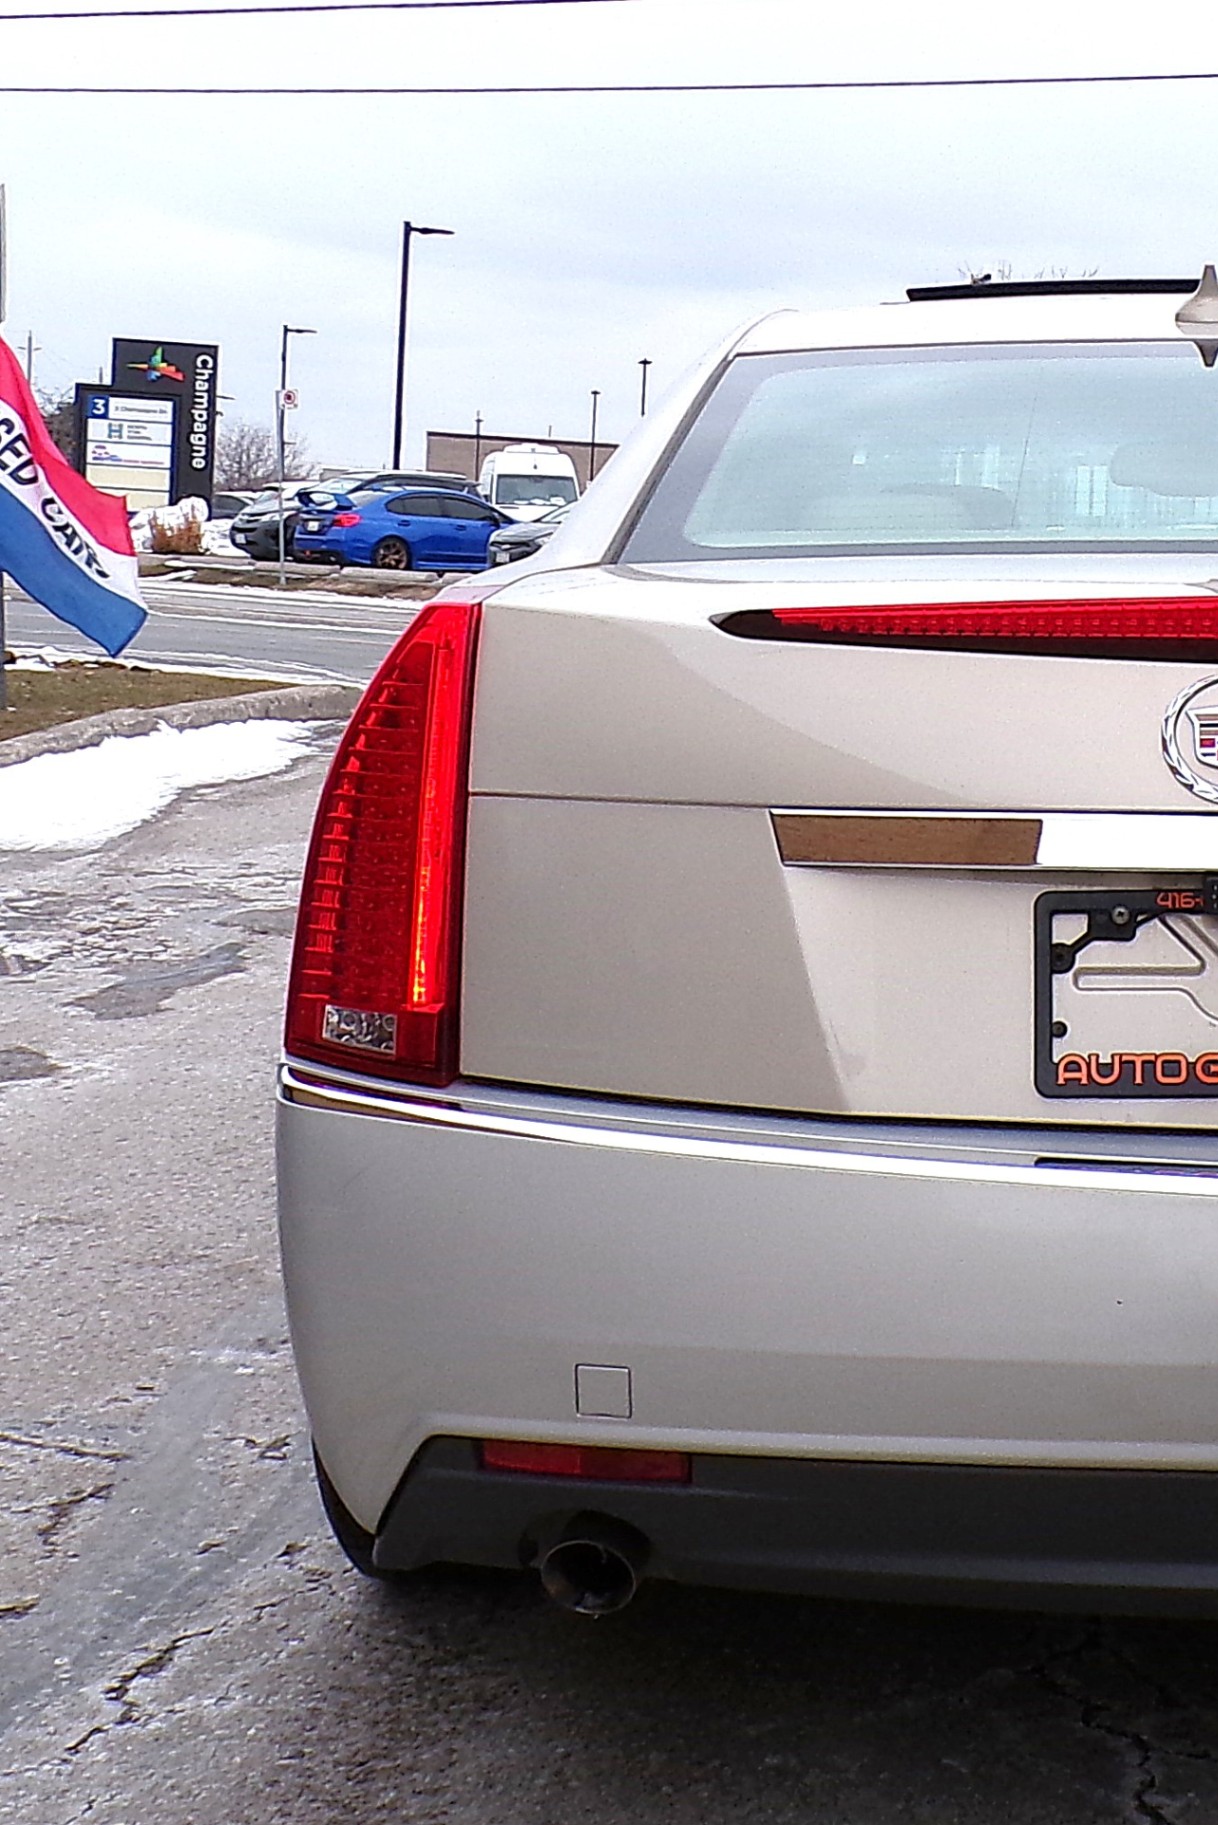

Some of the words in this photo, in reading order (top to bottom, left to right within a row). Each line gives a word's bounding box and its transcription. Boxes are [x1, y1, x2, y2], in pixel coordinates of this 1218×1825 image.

[92, 397, 106, 415] 3
[188, 354, 214, 469] Champagne
[1056, 1052, 1189, 1085] AUTO
